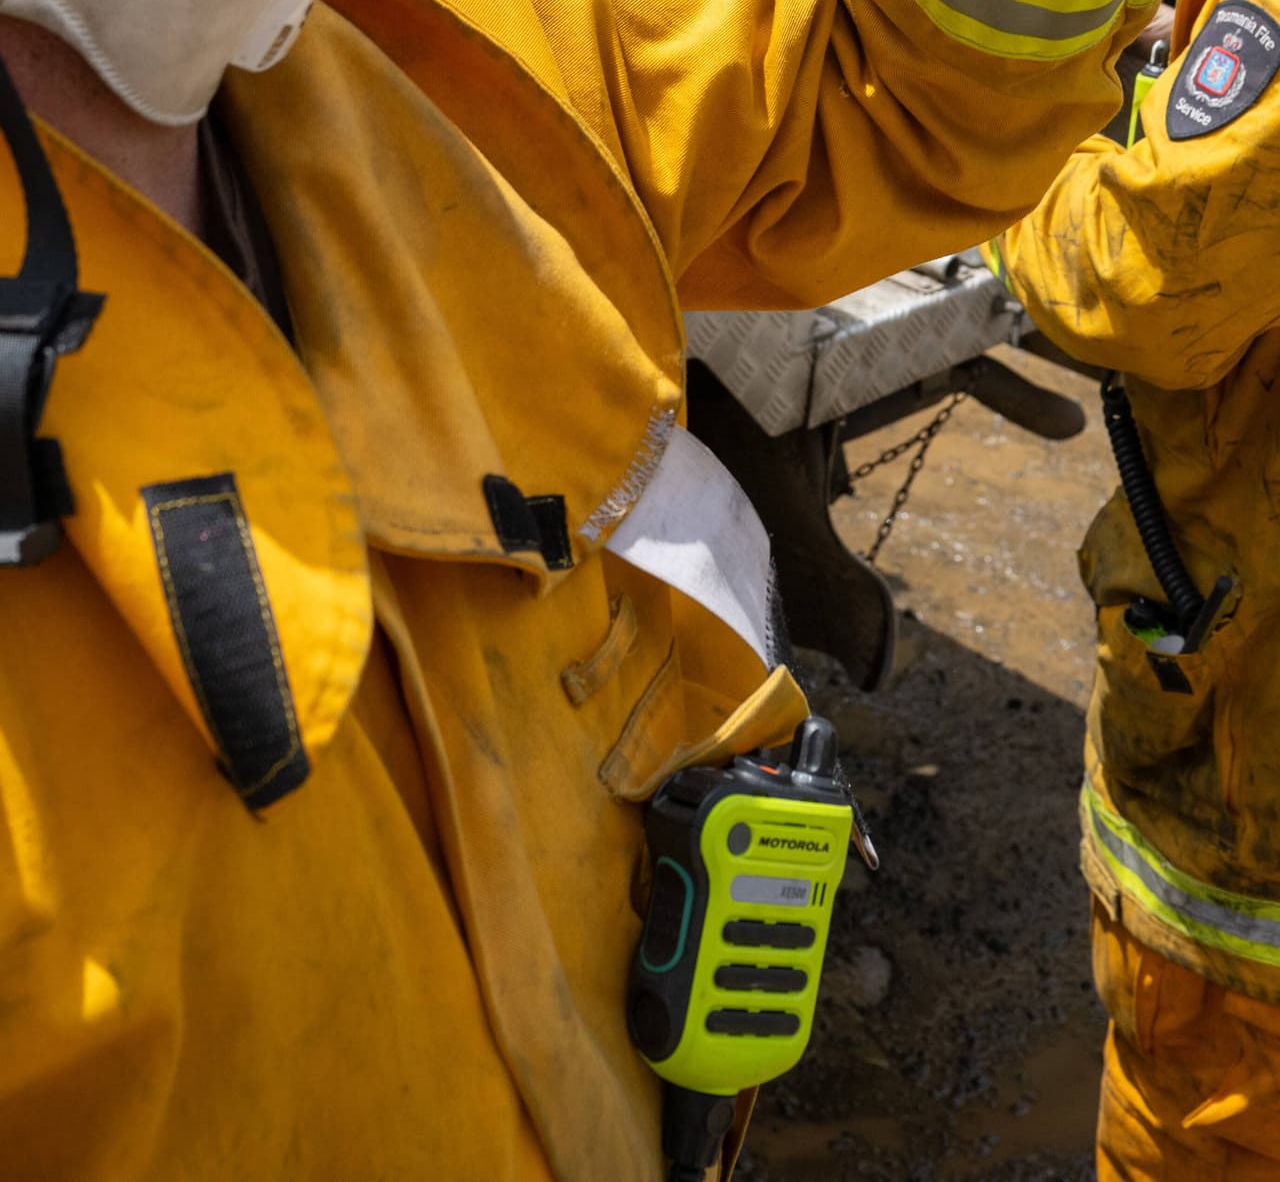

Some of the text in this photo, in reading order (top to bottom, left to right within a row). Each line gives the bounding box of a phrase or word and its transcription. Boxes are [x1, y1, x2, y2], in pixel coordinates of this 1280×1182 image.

[1216, 9, 1276, 51] Tasmania Fire
[1175, 97, 1212, 126] Service
[758, 836, 830, 853] MOTOROLA
